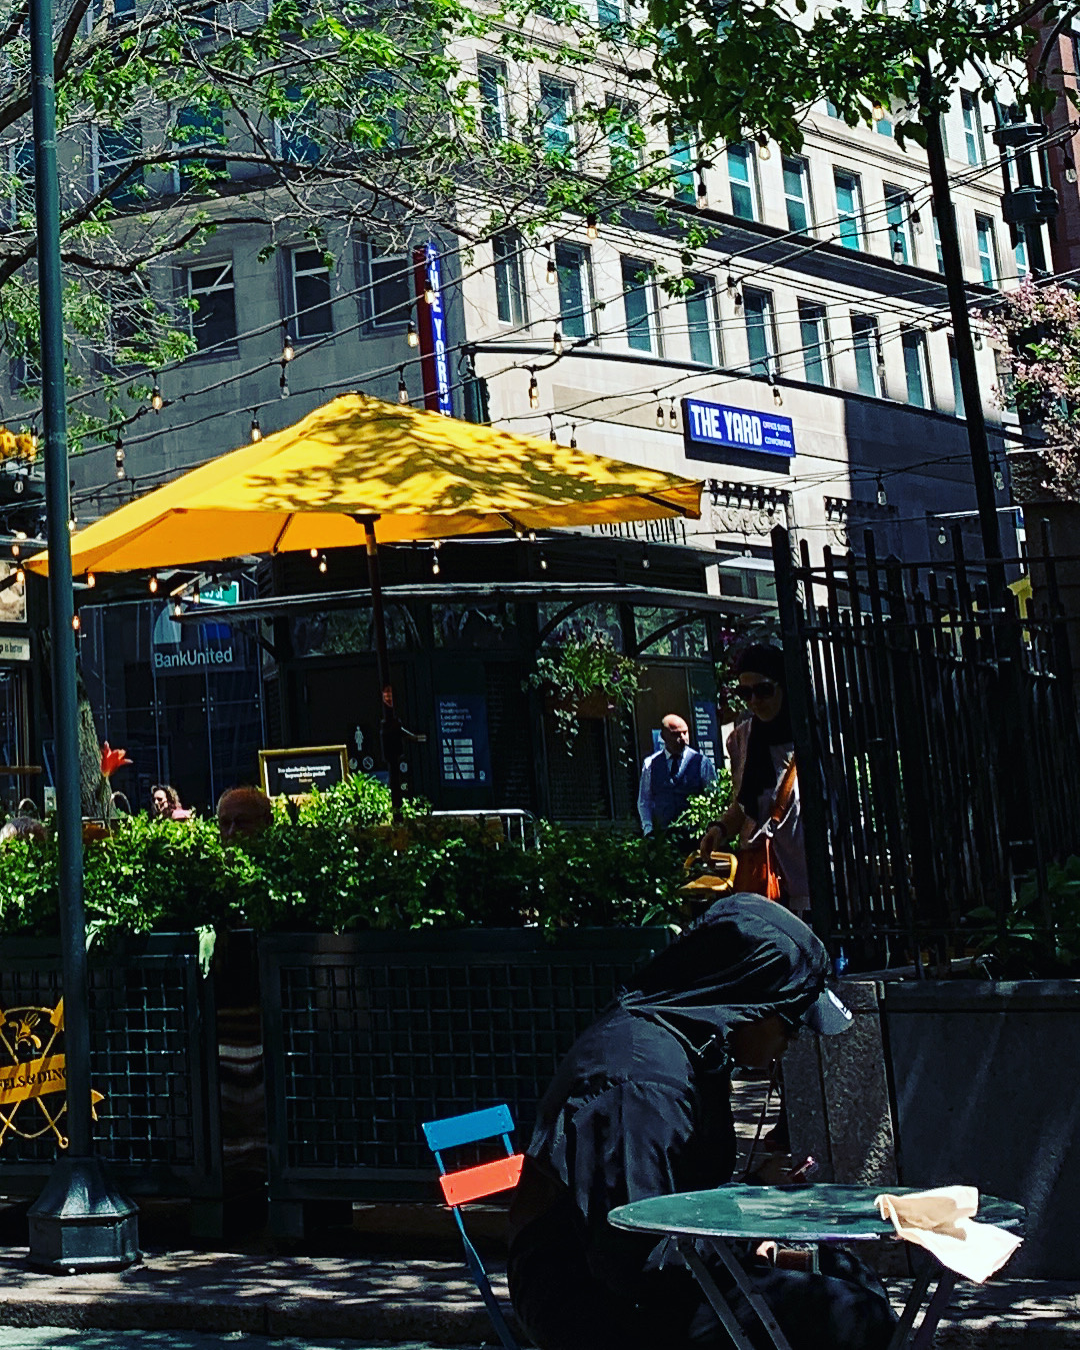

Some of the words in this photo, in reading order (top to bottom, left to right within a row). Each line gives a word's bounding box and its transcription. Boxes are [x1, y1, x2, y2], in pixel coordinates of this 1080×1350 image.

[689, 404, 723, 440] THE
[722, 410, 763, 447] YARD
[153, 645, 234, 668] BankUnited
